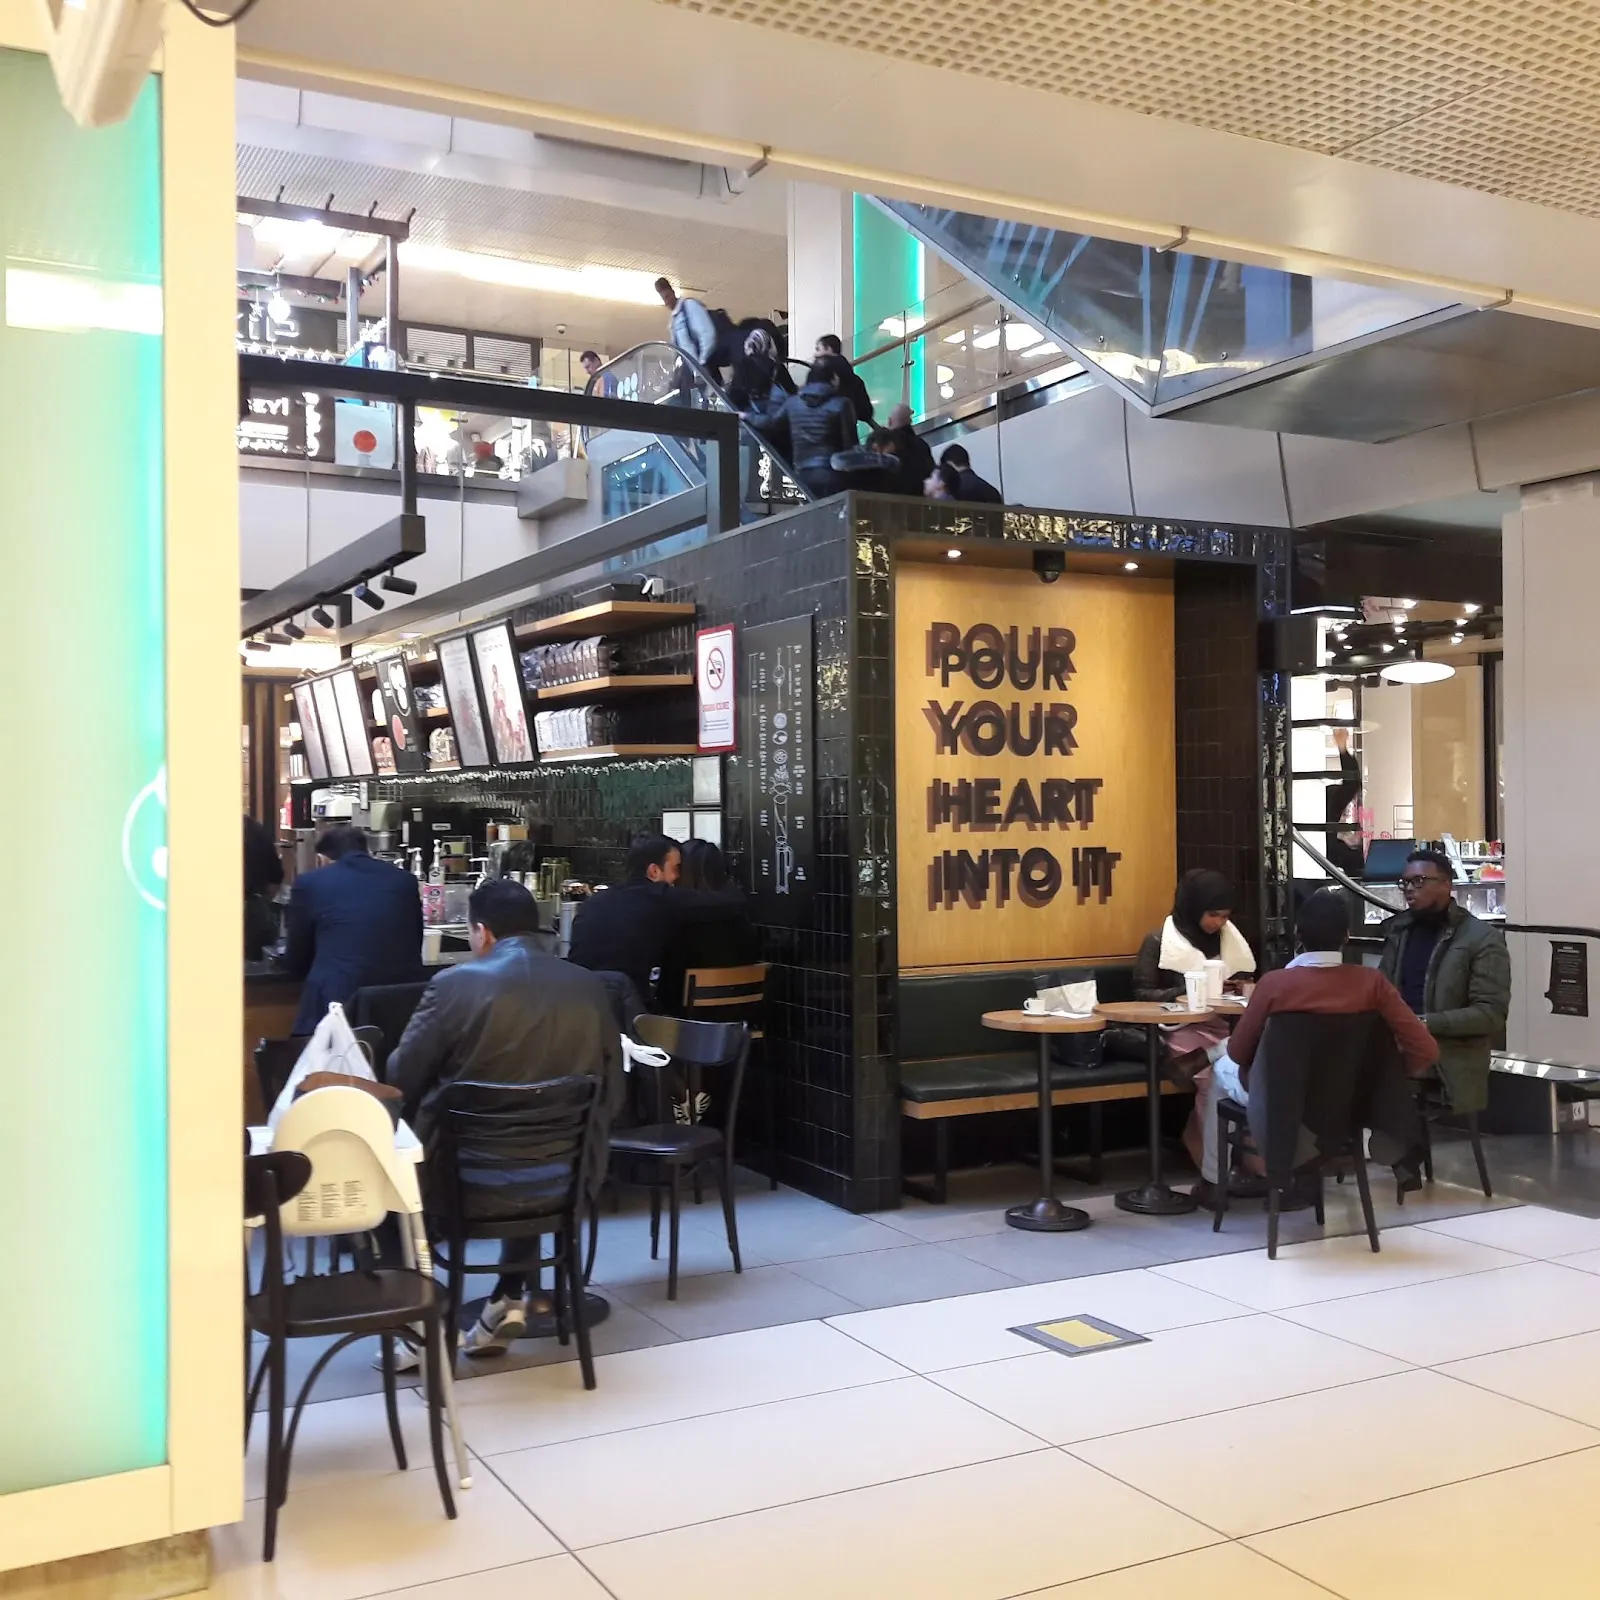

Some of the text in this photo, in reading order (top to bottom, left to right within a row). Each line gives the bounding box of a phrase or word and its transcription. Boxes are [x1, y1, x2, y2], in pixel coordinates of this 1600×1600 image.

[925, 622, 1077, 691] POUR
[921, 700, 1079, 757] YOUR
[927, 778, 1103, 832] HEART
[927, 846, 1121, 911] INTO IT
